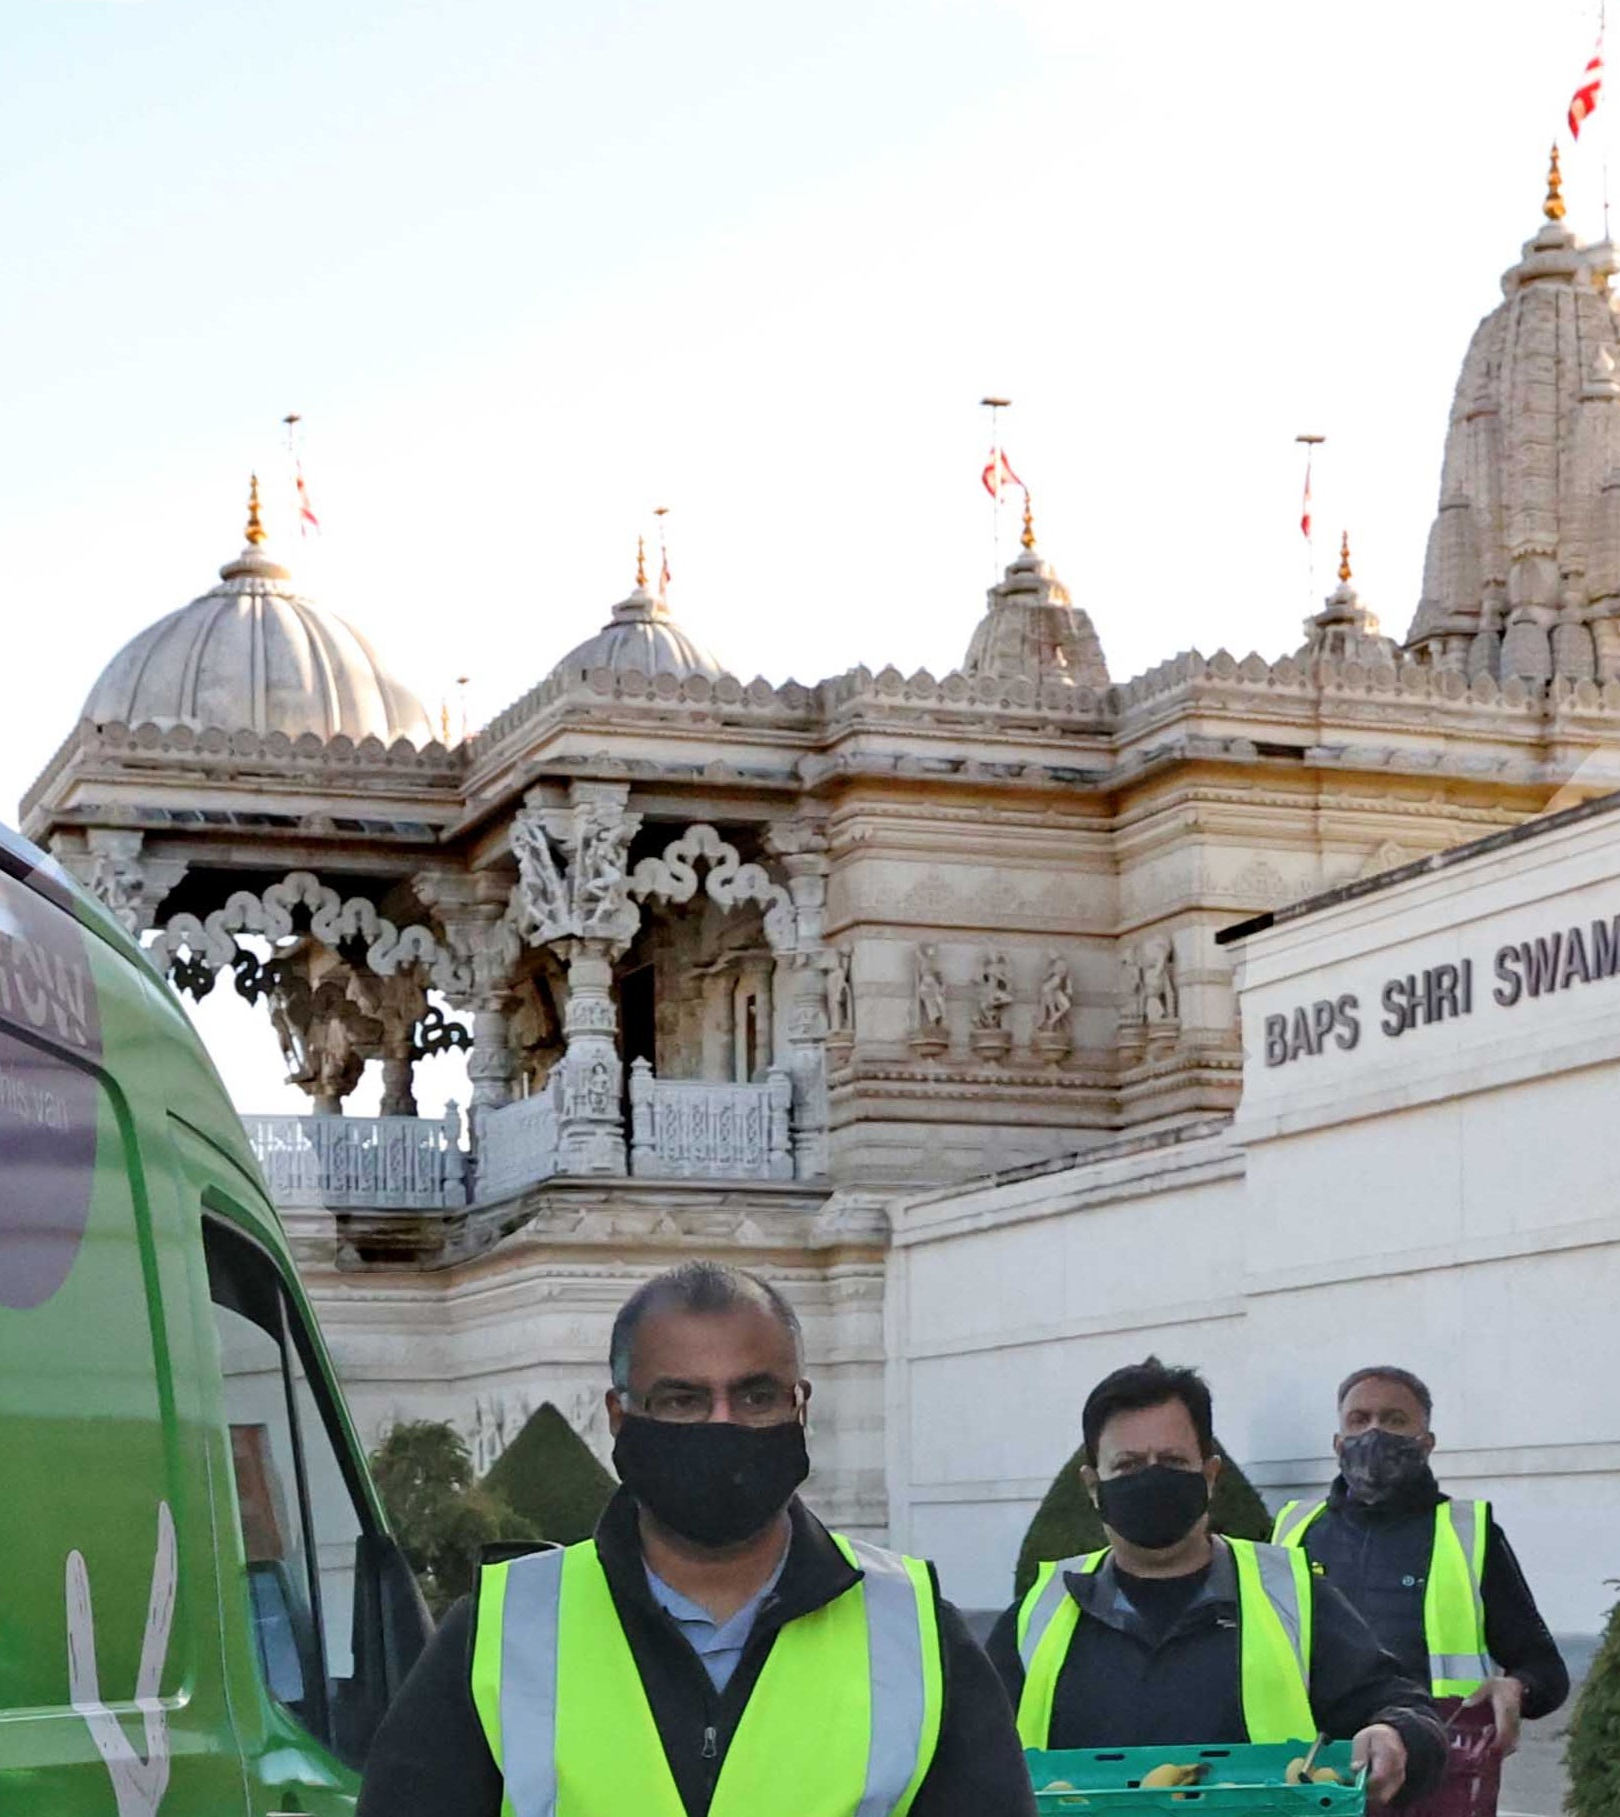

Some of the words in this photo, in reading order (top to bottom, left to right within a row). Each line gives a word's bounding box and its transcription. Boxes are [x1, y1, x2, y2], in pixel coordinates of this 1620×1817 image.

[1264, 994, 1360, 1068] BAPS
[1381, 958, 1473, 1038] SHRI
[30, 1086, 71, 1134] van
